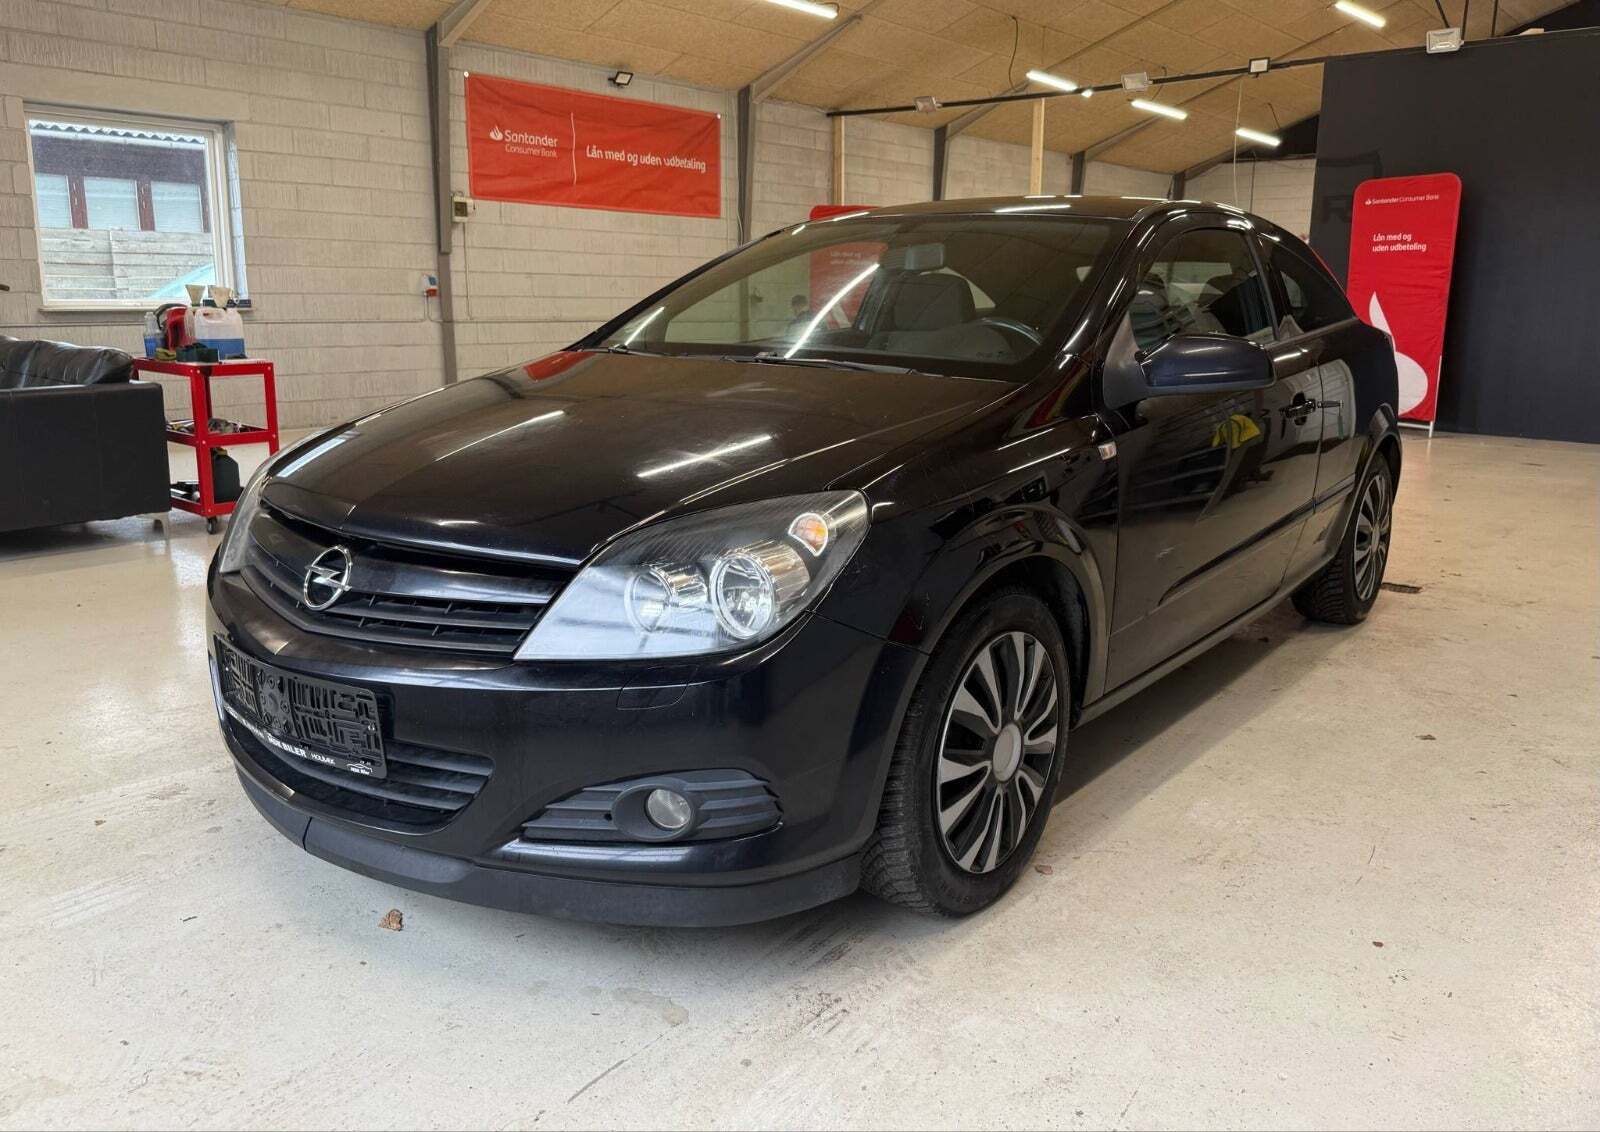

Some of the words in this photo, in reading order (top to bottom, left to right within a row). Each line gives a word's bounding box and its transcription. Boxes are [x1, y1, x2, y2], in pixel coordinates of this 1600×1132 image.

[504, 129, 558, 148] Santander
[505, 143, 541, 156] Consumer
[541, 148, 558, 158] Bank
[586, 144, 603, 159] Lån
[605, 149, 625, 161] med
[627, 152, 639, 166] og
[640, 152, 662, 166] uden
[663, 155, 706, 174] udbetaling
[1371, 197, 1399, 205] Santander
[1399, 195, 1425, 203] Consumer
[1373, 232, 1386, 242] Lån
[1386, 231, 1402, 241] med
[1402, 233, 1412, 242] og
[1372, 243, 1389, 252] uden
[1389, 241, 1427, 252] udbetaling
[281, 742, 307, 758] BILER
